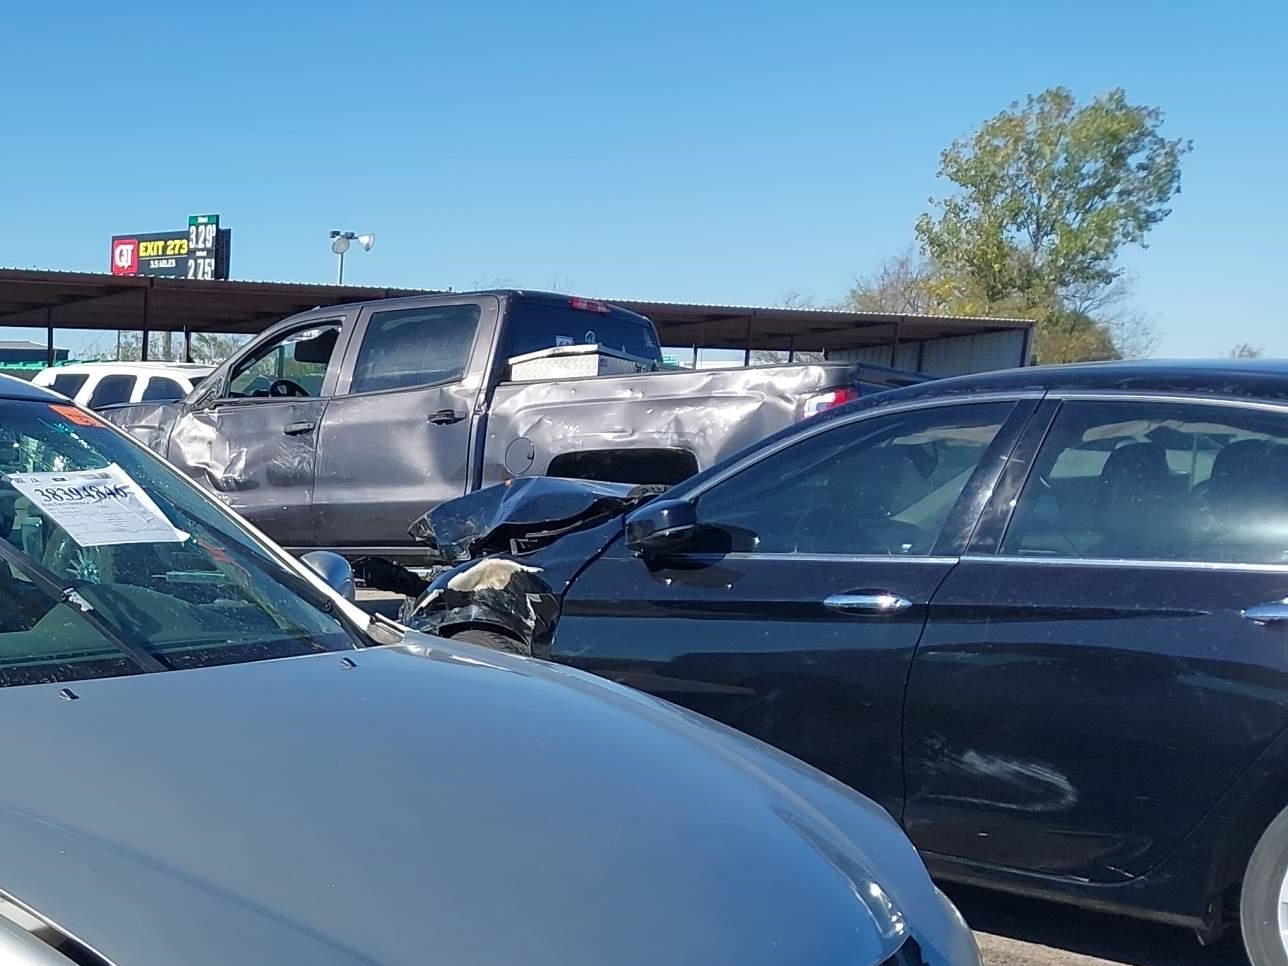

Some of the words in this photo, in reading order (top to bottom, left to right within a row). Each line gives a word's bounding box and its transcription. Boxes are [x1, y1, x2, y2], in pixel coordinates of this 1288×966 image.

[114, 244, 134, 269] QT
[139, 241, 165, 257] EXIT
[166, 239, 189, 255] 273
[34, 484, 128, 503] 38394846
